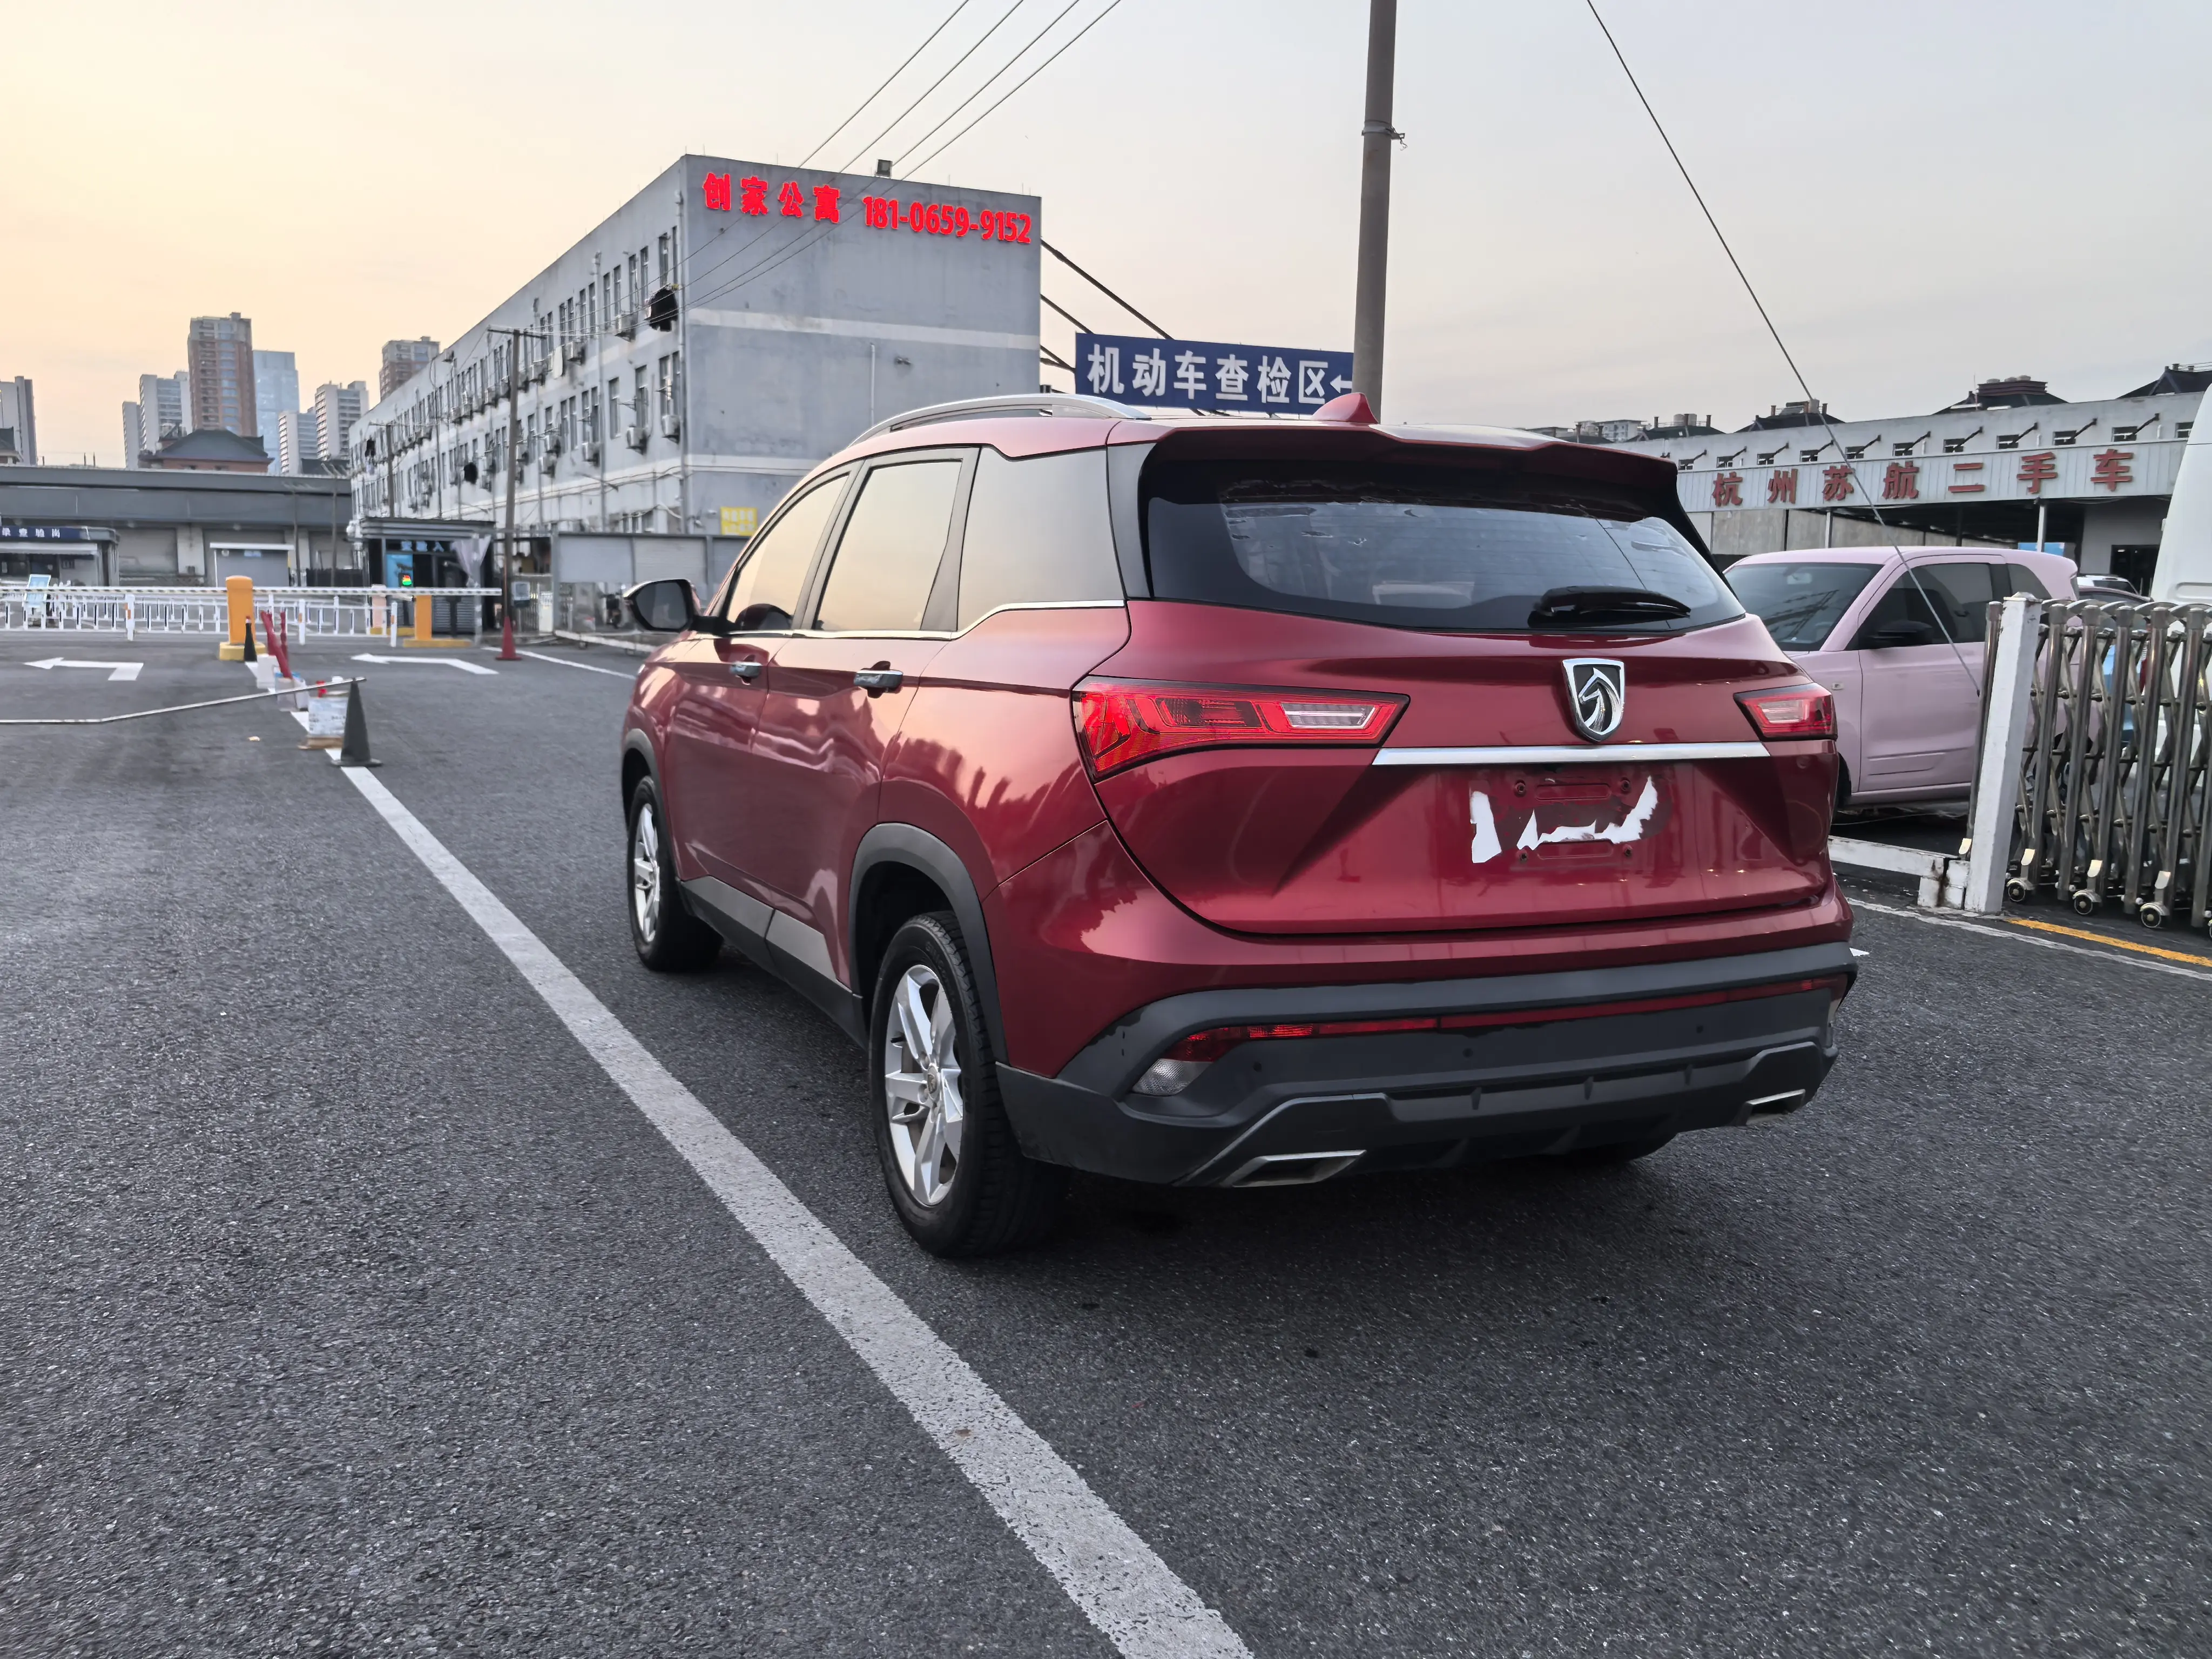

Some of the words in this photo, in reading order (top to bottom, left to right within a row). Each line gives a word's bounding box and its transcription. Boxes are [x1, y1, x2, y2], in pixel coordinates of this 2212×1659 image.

[702, 172, 840, 224] 创家公寓
[862, 195, 1031, 244] 181-0659-9152
[1087, 343, 1329, 404] 机动车查检区
[1712, 449, 2133, 507] 杭州苏航二手车
